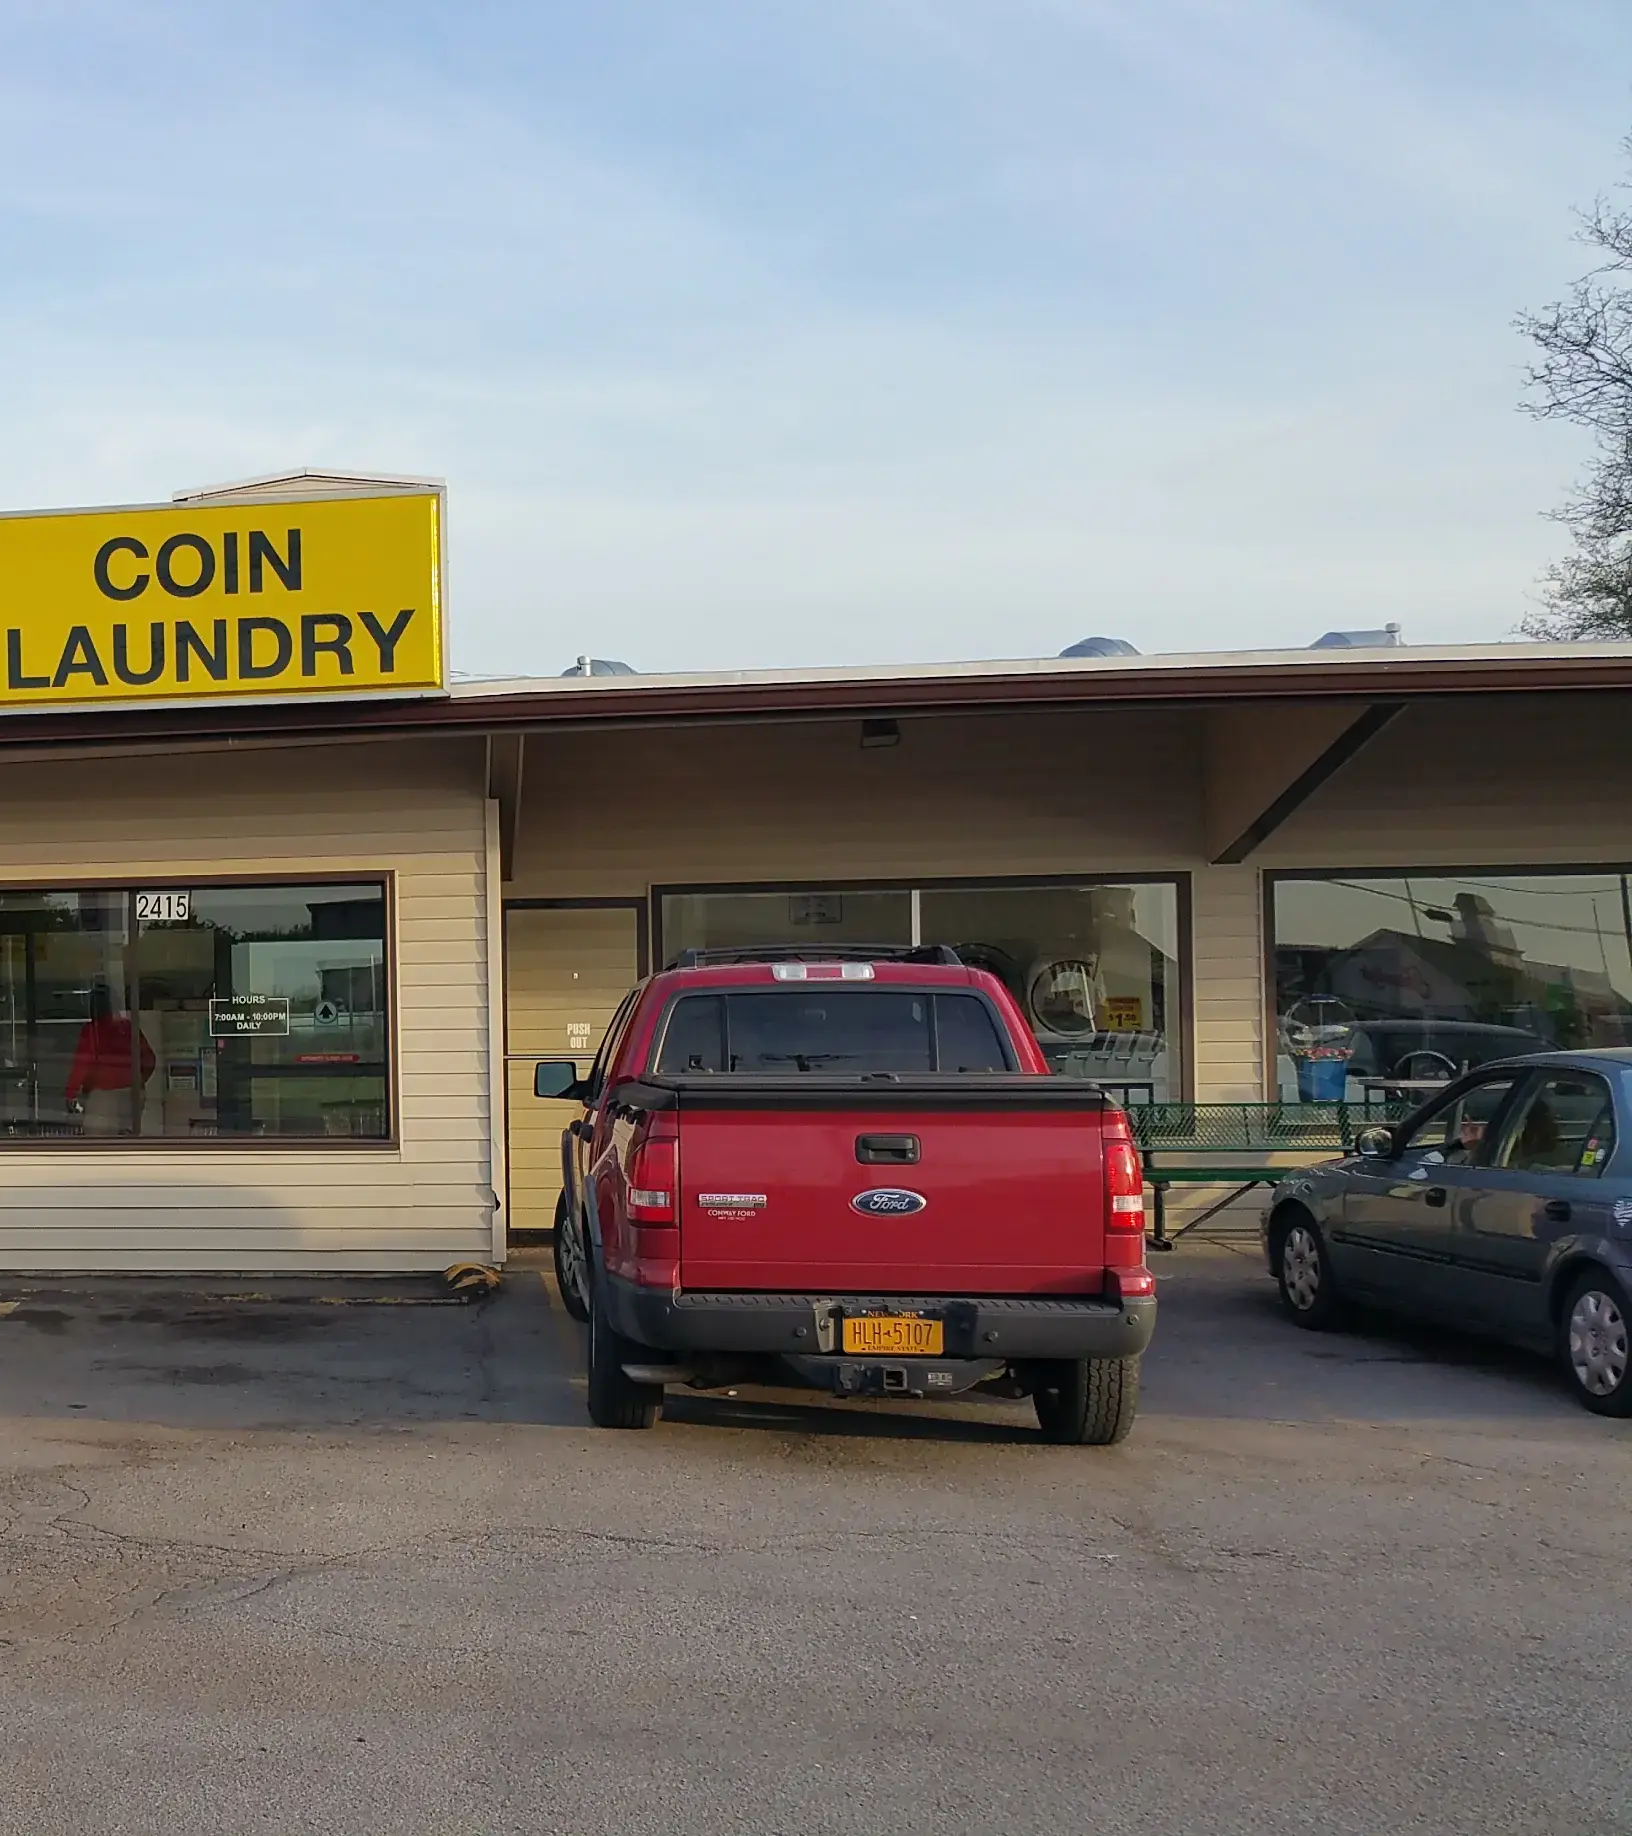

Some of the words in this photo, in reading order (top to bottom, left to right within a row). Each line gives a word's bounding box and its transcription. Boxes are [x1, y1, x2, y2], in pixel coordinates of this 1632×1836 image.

[94, 528, 302, 601] COIN
[7, 609, 416, 689] LAUNDRY
[138, 895, 187, 919] 2415
[232, 995, 266, 1004] HOURS
[214, 1013, 245, 1021] 7:00AM
[252, 1012, 286, 1021] 10:00PM
[236, 1021, 262, 1030] DAILY
[567, 1023, 591, 1036] PUSH
[570, 1036, 588, 1049] OUT
[737, 1195, 765, 1203] TRAC
[869, 1193, 910, 1210] Ford
[707, 1209, 736, 1217] CONWAY
